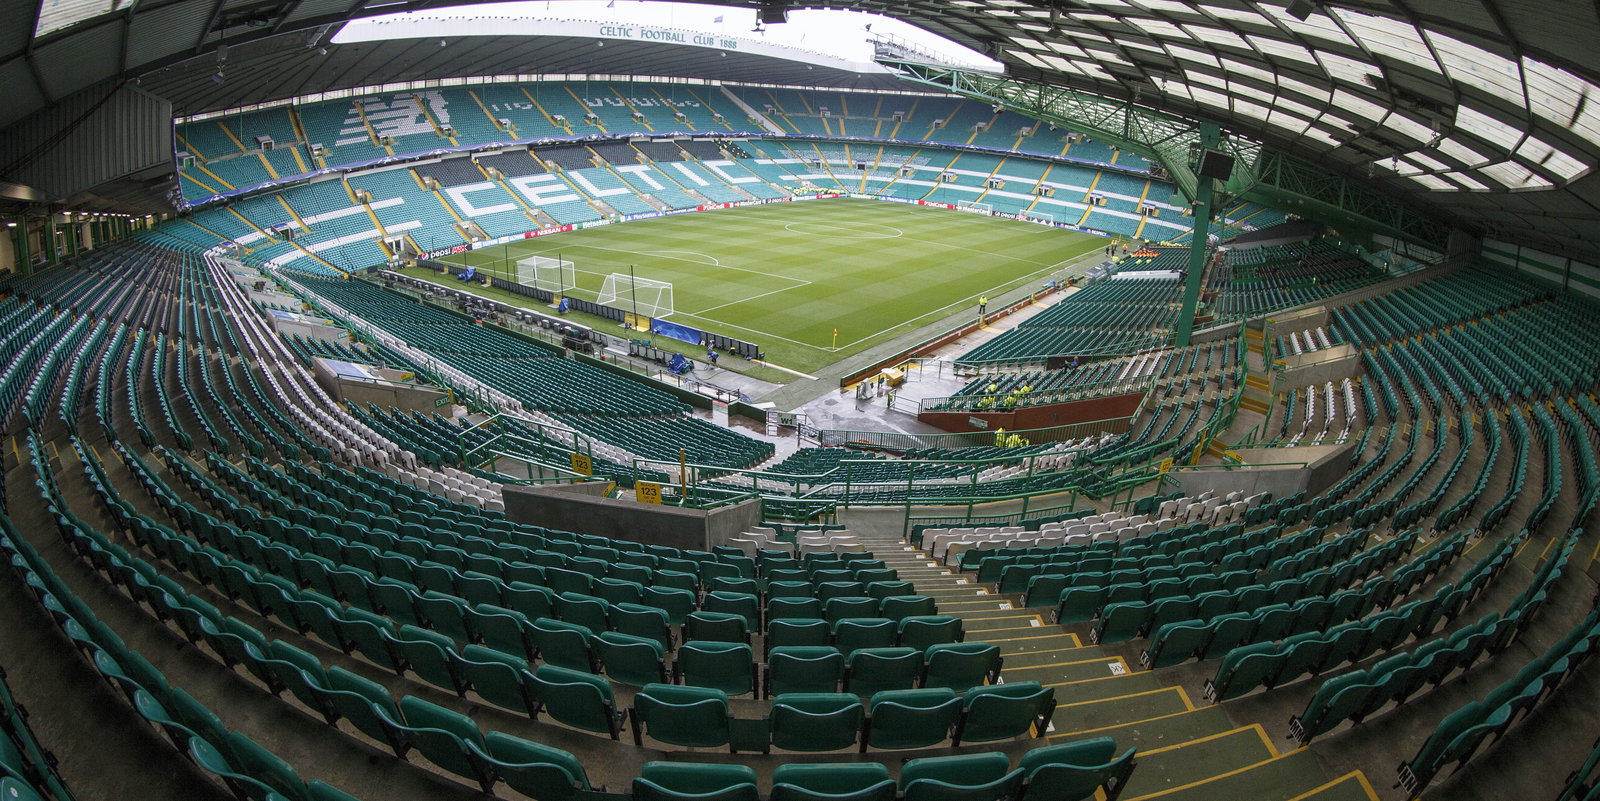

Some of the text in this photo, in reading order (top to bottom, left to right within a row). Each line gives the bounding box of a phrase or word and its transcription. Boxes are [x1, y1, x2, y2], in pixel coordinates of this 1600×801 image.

[600, 26, 737, 49] CELTIC FOOTBALL CLUB 1888
[445, 160, 761, 218] CELTIC
[537, 227, 561, 237] NISSAN
[430, 248, 451, 259] pepsi
[575, 459, 589, 470] 123
[641, 486, 657, 497] 123
